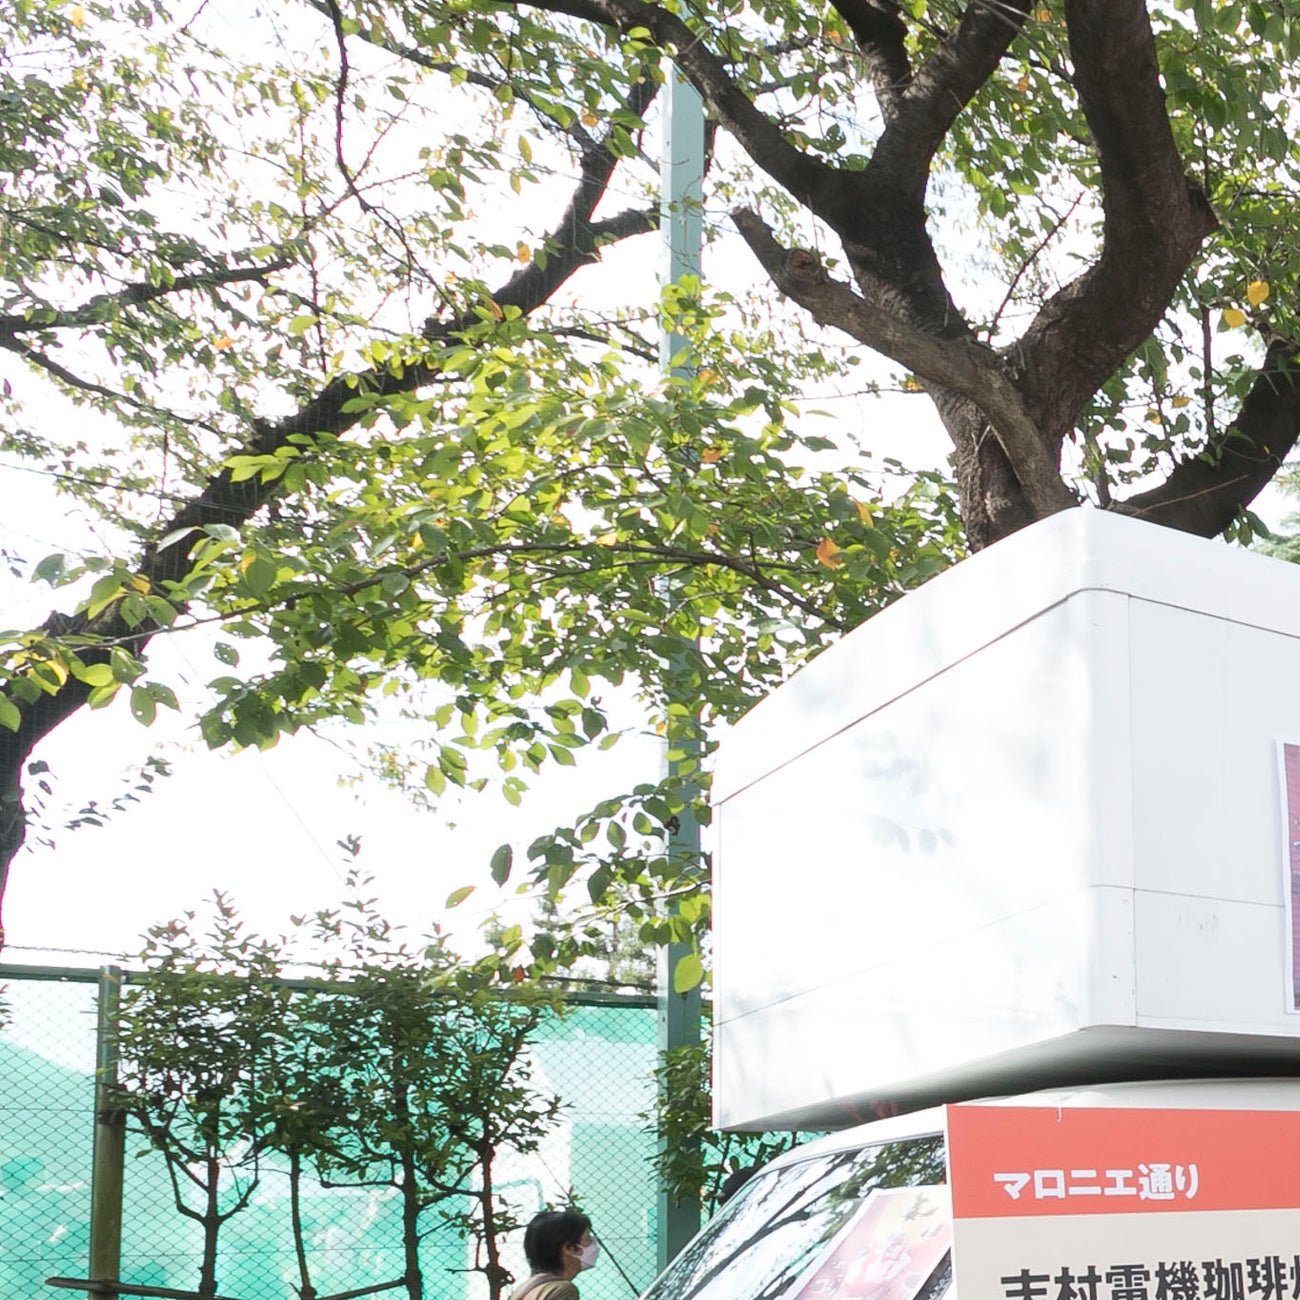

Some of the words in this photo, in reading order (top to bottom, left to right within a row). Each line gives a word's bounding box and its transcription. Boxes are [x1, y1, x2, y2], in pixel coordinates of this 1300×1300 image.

[993, 1163, 1199, 1200] マロニエ通り
